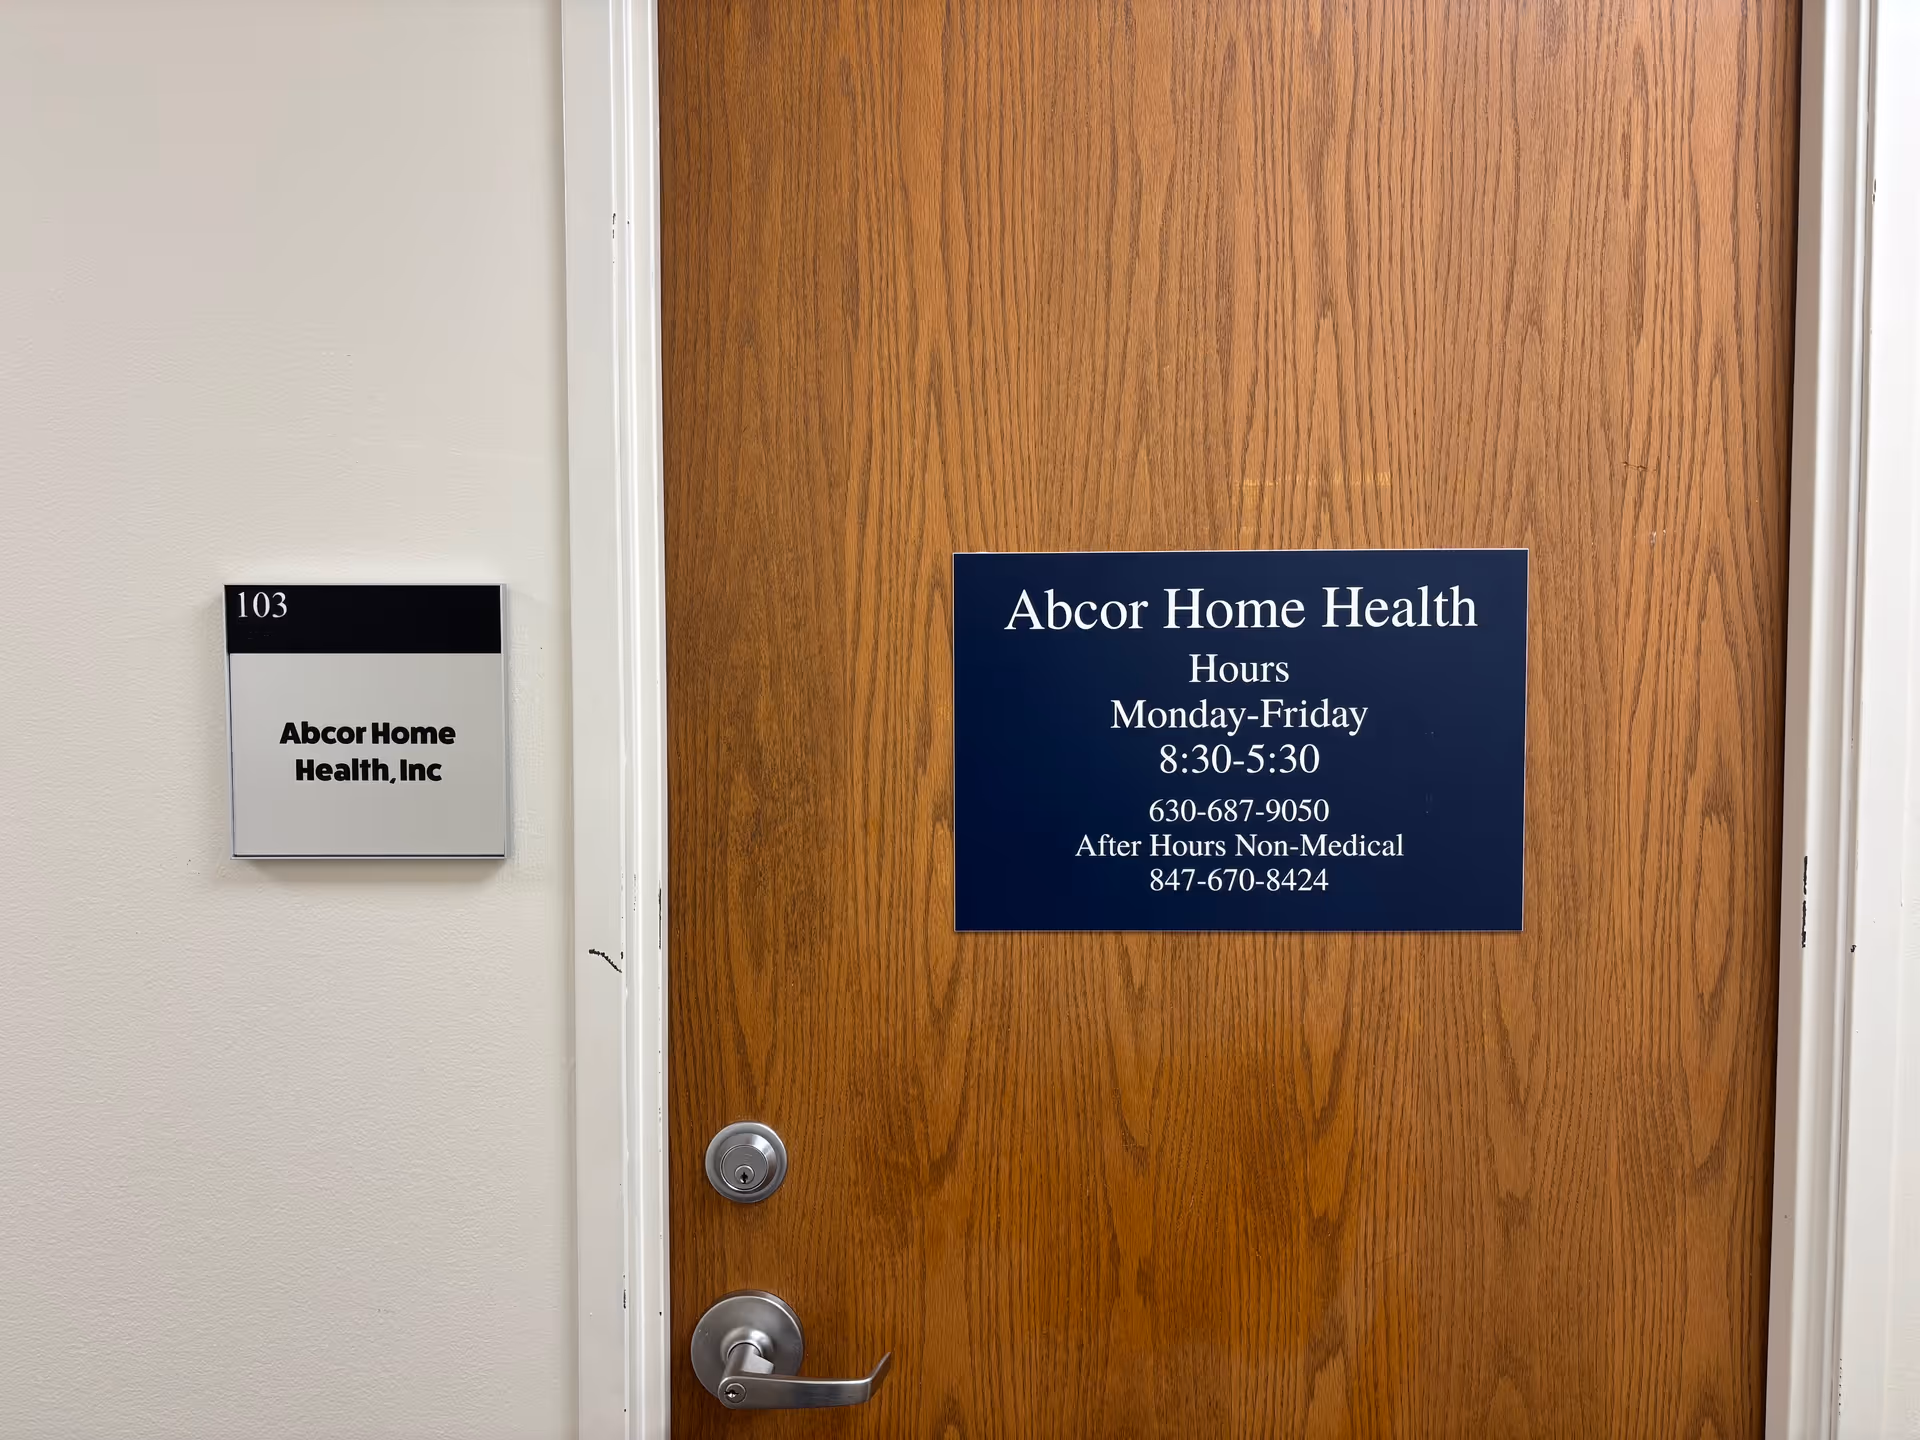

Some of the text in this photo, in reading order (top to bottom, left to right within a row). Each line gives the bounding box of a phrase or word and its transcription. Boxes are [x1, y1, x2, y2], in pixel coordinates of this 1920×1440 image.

[237, 591, 288, 618] 103
[1003, 584, 1479, 630] Abcor Home Health
[1188, 653, 1290, 683] Hours
[1110, 697, 1369, 737] Monday-Friday
[279, 720, 457, 745] Abcor Home
[295, 757, 443, 785] Health, Inc
[1159, 743, 1320, 774] 8:30-5:30
[1149, 798, 1330, 822] 630-687-9050
[1075, 833, 1404, 857] After Hours Non-Medical
[1149, 868, 1329, 892] 847-670-8424
